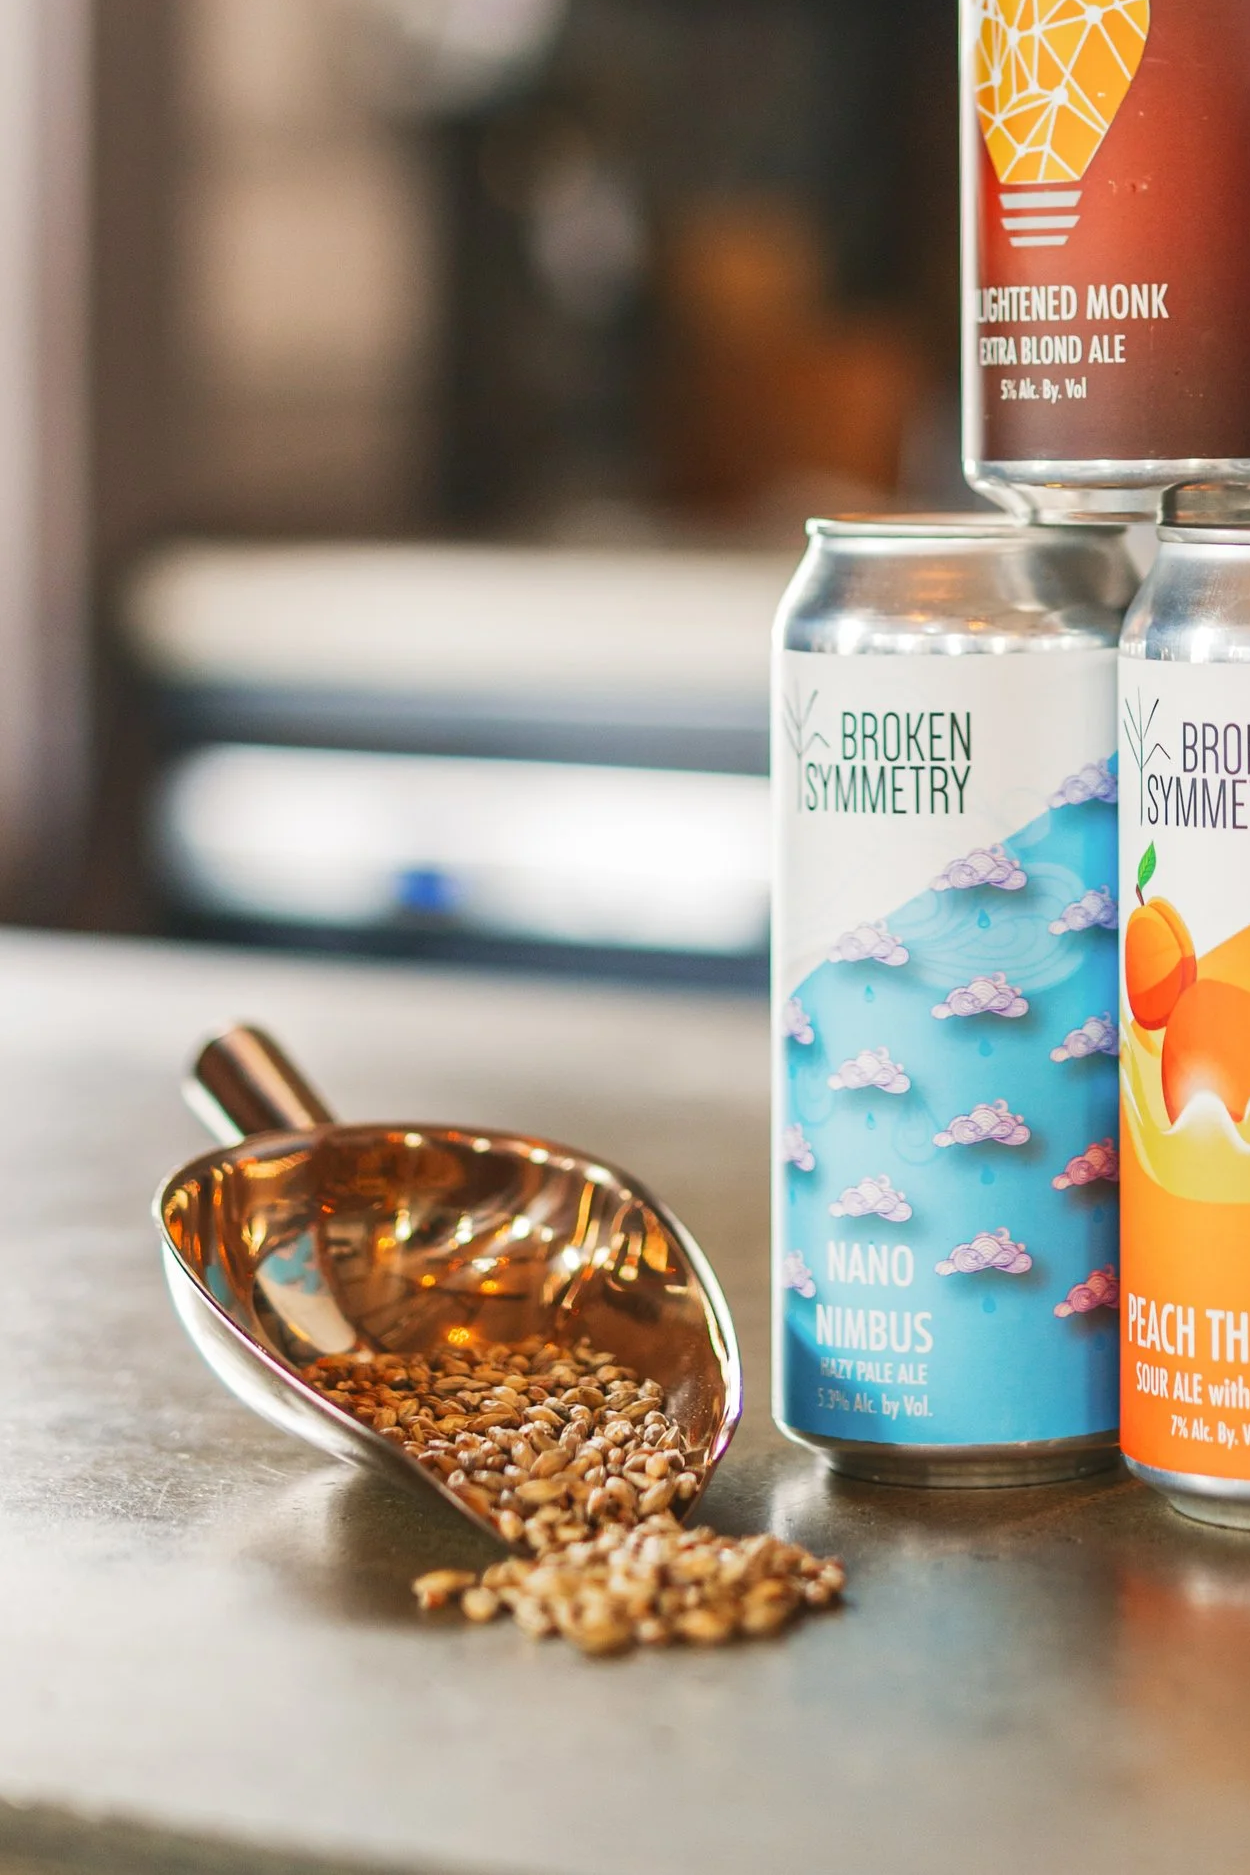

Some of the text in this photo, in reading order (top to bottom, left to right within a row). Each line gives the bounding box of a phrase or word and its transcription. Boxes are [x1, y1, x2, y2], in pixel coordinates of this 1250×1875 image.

[1086, 283, 1169, 320] MONK
[980, 334, 1126, 366] EXTRA BLOND ALE
[1000, 376, 1087, 404] 5% Alc. By. Vol
[841, 712, 971, 762] BROKEN
[805, 762, 971, 814] SYMMETRY
[827, 1240, 915, 1287] NANO
[816, 1304, 934, 1353] NIMBUS
[1128, 1292, 1195, 1358] PEACH
[820, 1356, 928, 1385] HAZY PALE ALE
[1136, 1361, 1168, 1399] SOUR
[1173, 1372, 1203, 1405] ALE
[1208, 1374, 1250, 1409] with
[853, 1392, 878, 1414] Alc.
[881, 1394, 899, 1420] by
[903, 1395, 934, 1417] Vol.
[1170, 1414, 1188, 1438] 7%
[1191, 1416, 1213, 1442] Alc.
[1217, 1421, 1239, 1450] By.
